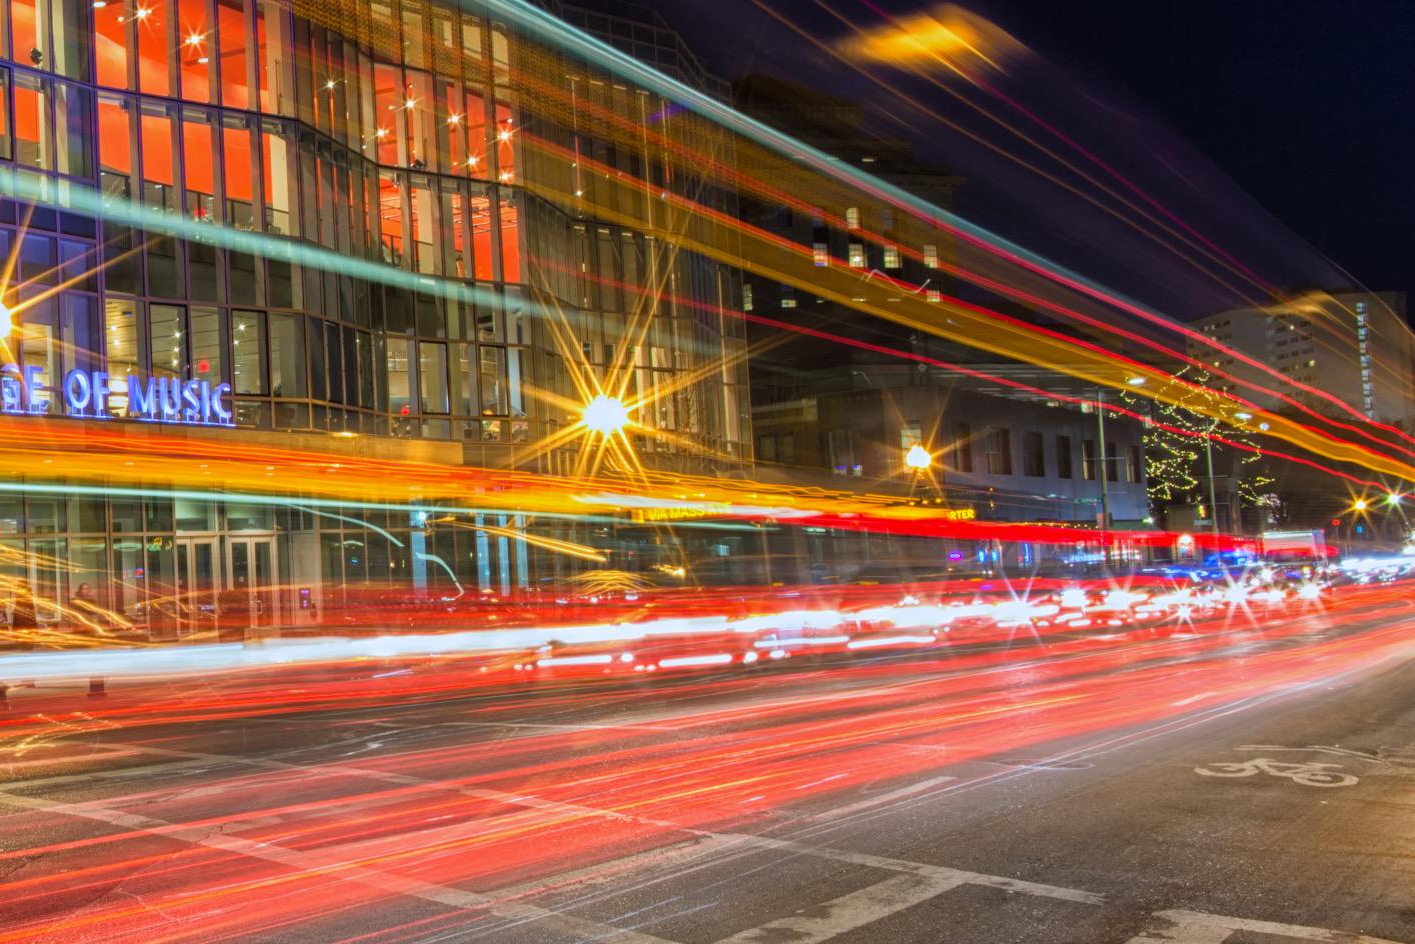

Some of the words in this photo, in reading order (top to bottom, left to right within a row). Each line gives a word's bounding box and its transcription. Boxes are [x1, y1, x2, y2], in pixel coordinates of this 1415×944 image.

[65, 369, 111, 410] OF
[127, 374, 233, 418] MUSIC
[669, 505, 705, 519] MASS
[947, 508, 975, 521] RTER
